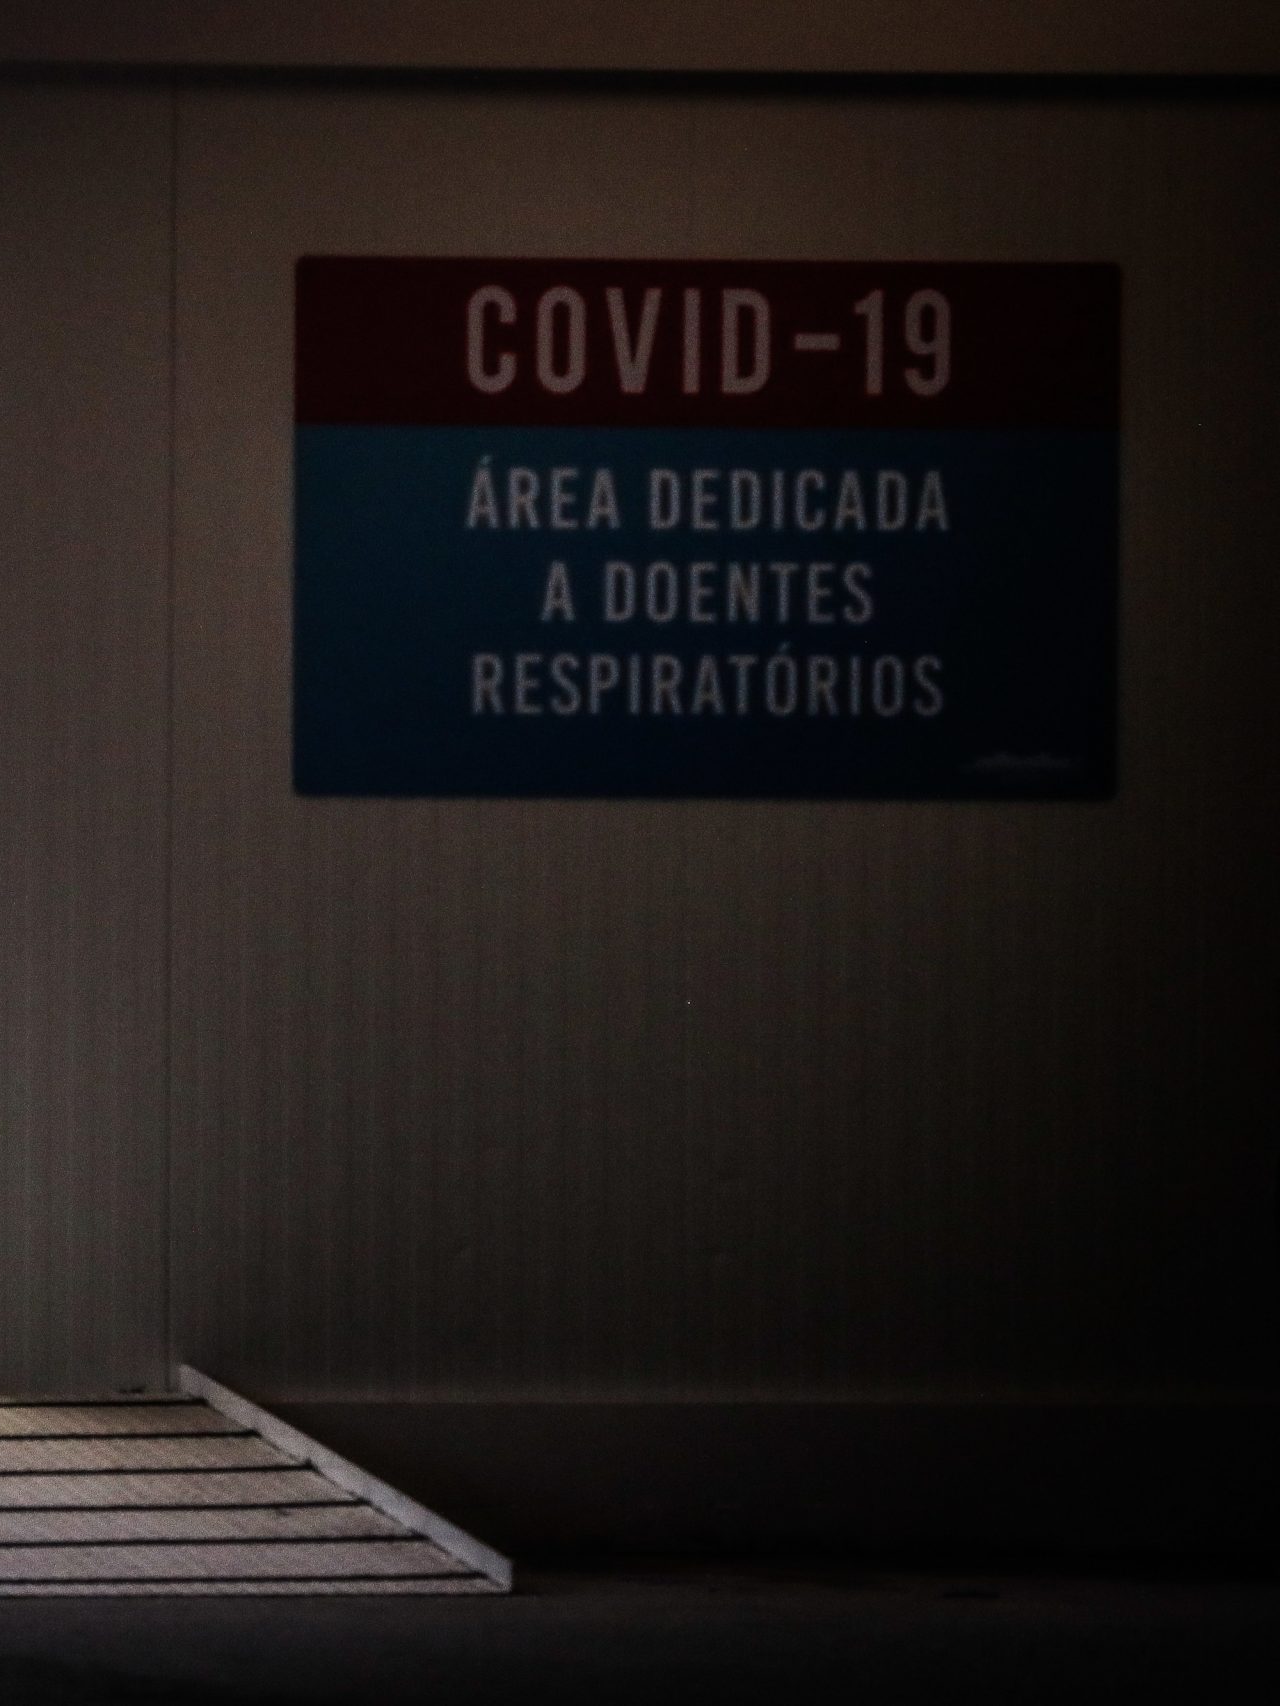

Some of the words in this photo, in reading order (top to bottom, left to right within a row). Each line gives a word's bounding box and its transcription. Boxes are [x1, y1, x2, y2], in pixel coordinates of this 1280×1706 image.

[465, 285, 954, 397] COVID-19
[465, 455, 622, 532] ÁREA
[650, 467, 951, 533] DEDICADA
[540, 561, 577, 623] A
[606, 561, 875, 625] DOENTES
[472, 642, 945, 717] RESPIRATÓRIOS
